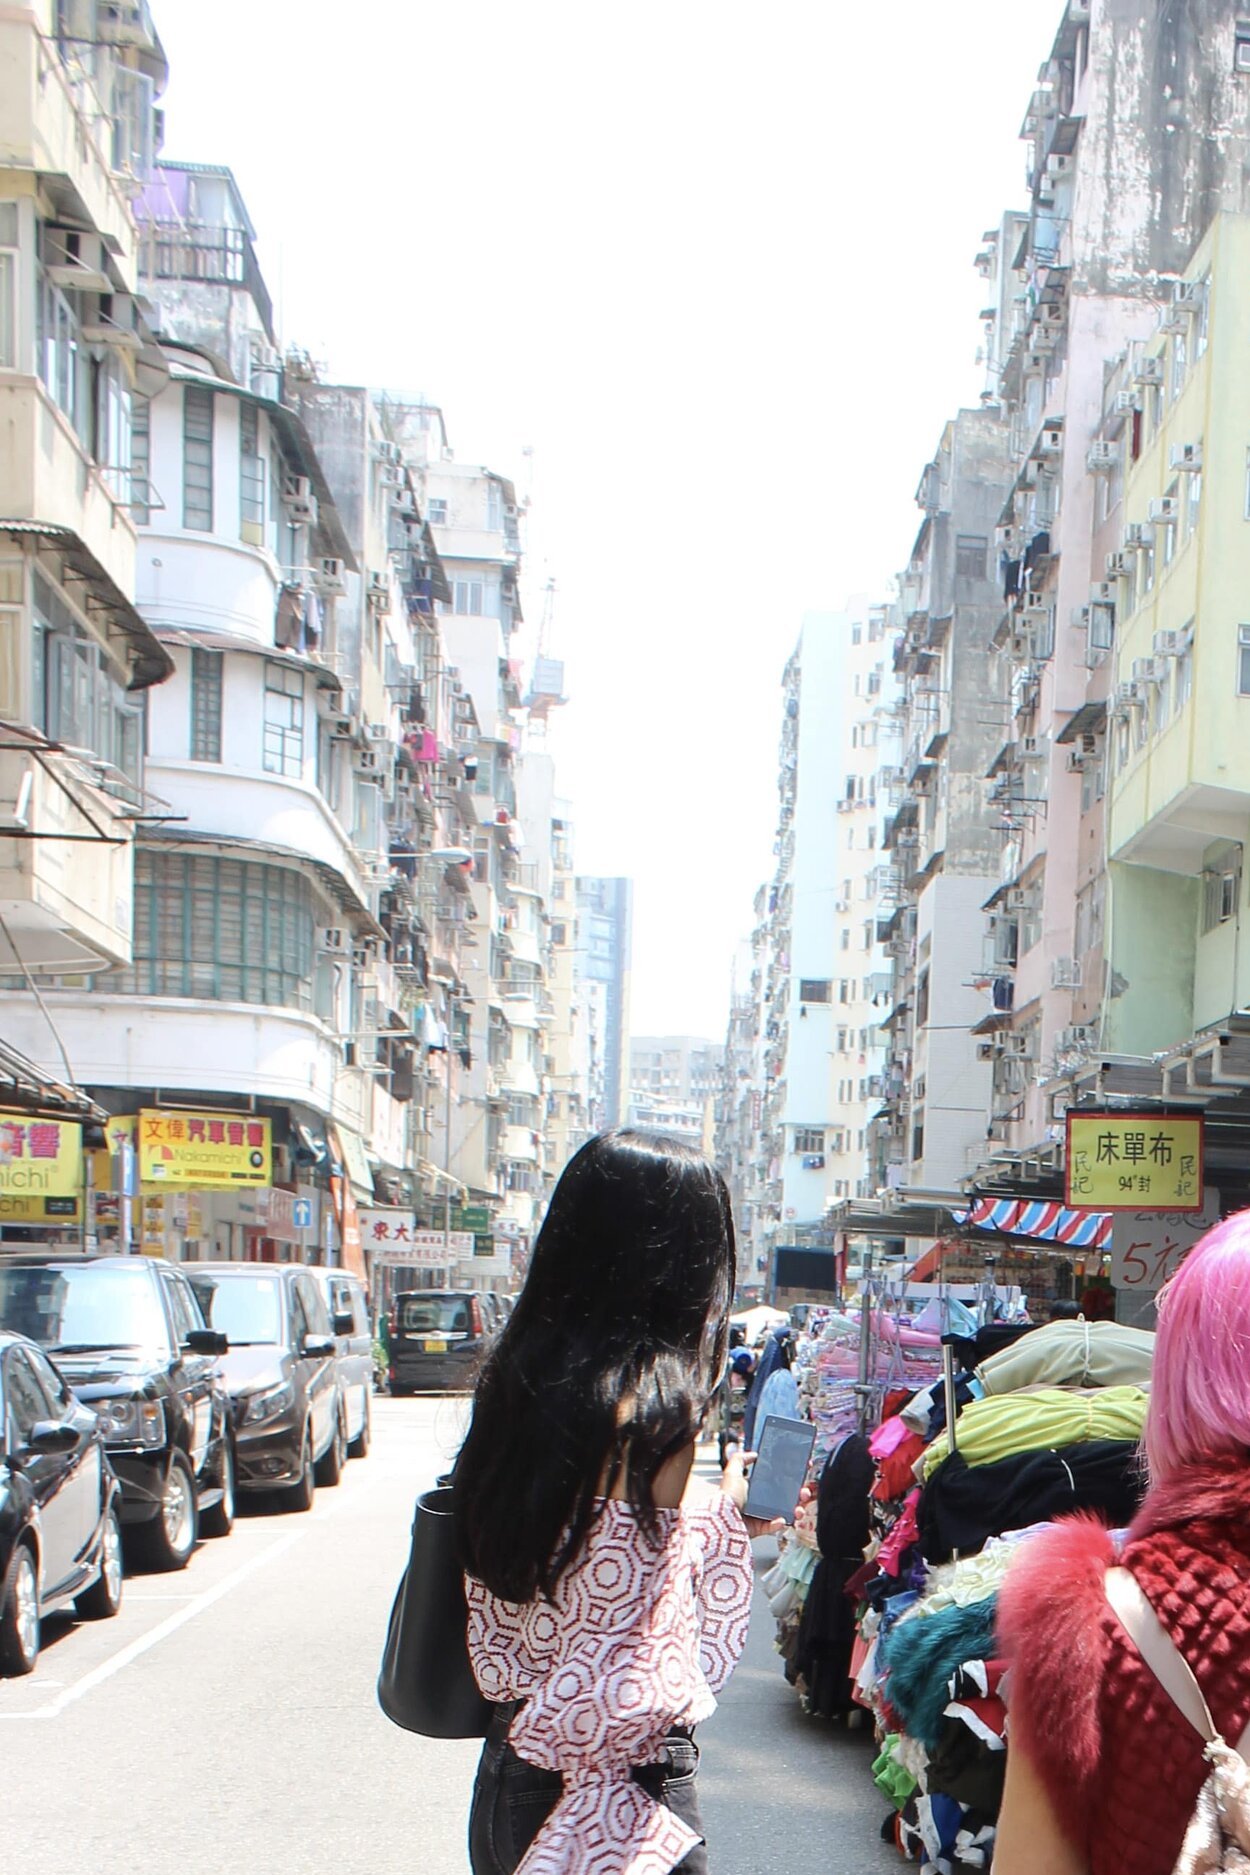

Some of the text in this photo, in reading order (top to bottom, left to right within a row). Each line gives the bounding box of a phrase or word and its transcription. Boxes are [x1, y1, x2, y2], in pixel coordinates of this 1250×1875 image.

[174, 1149, 242, 1166] Nakamichi
[1096, 1131, 1175, 1167] 床單布
